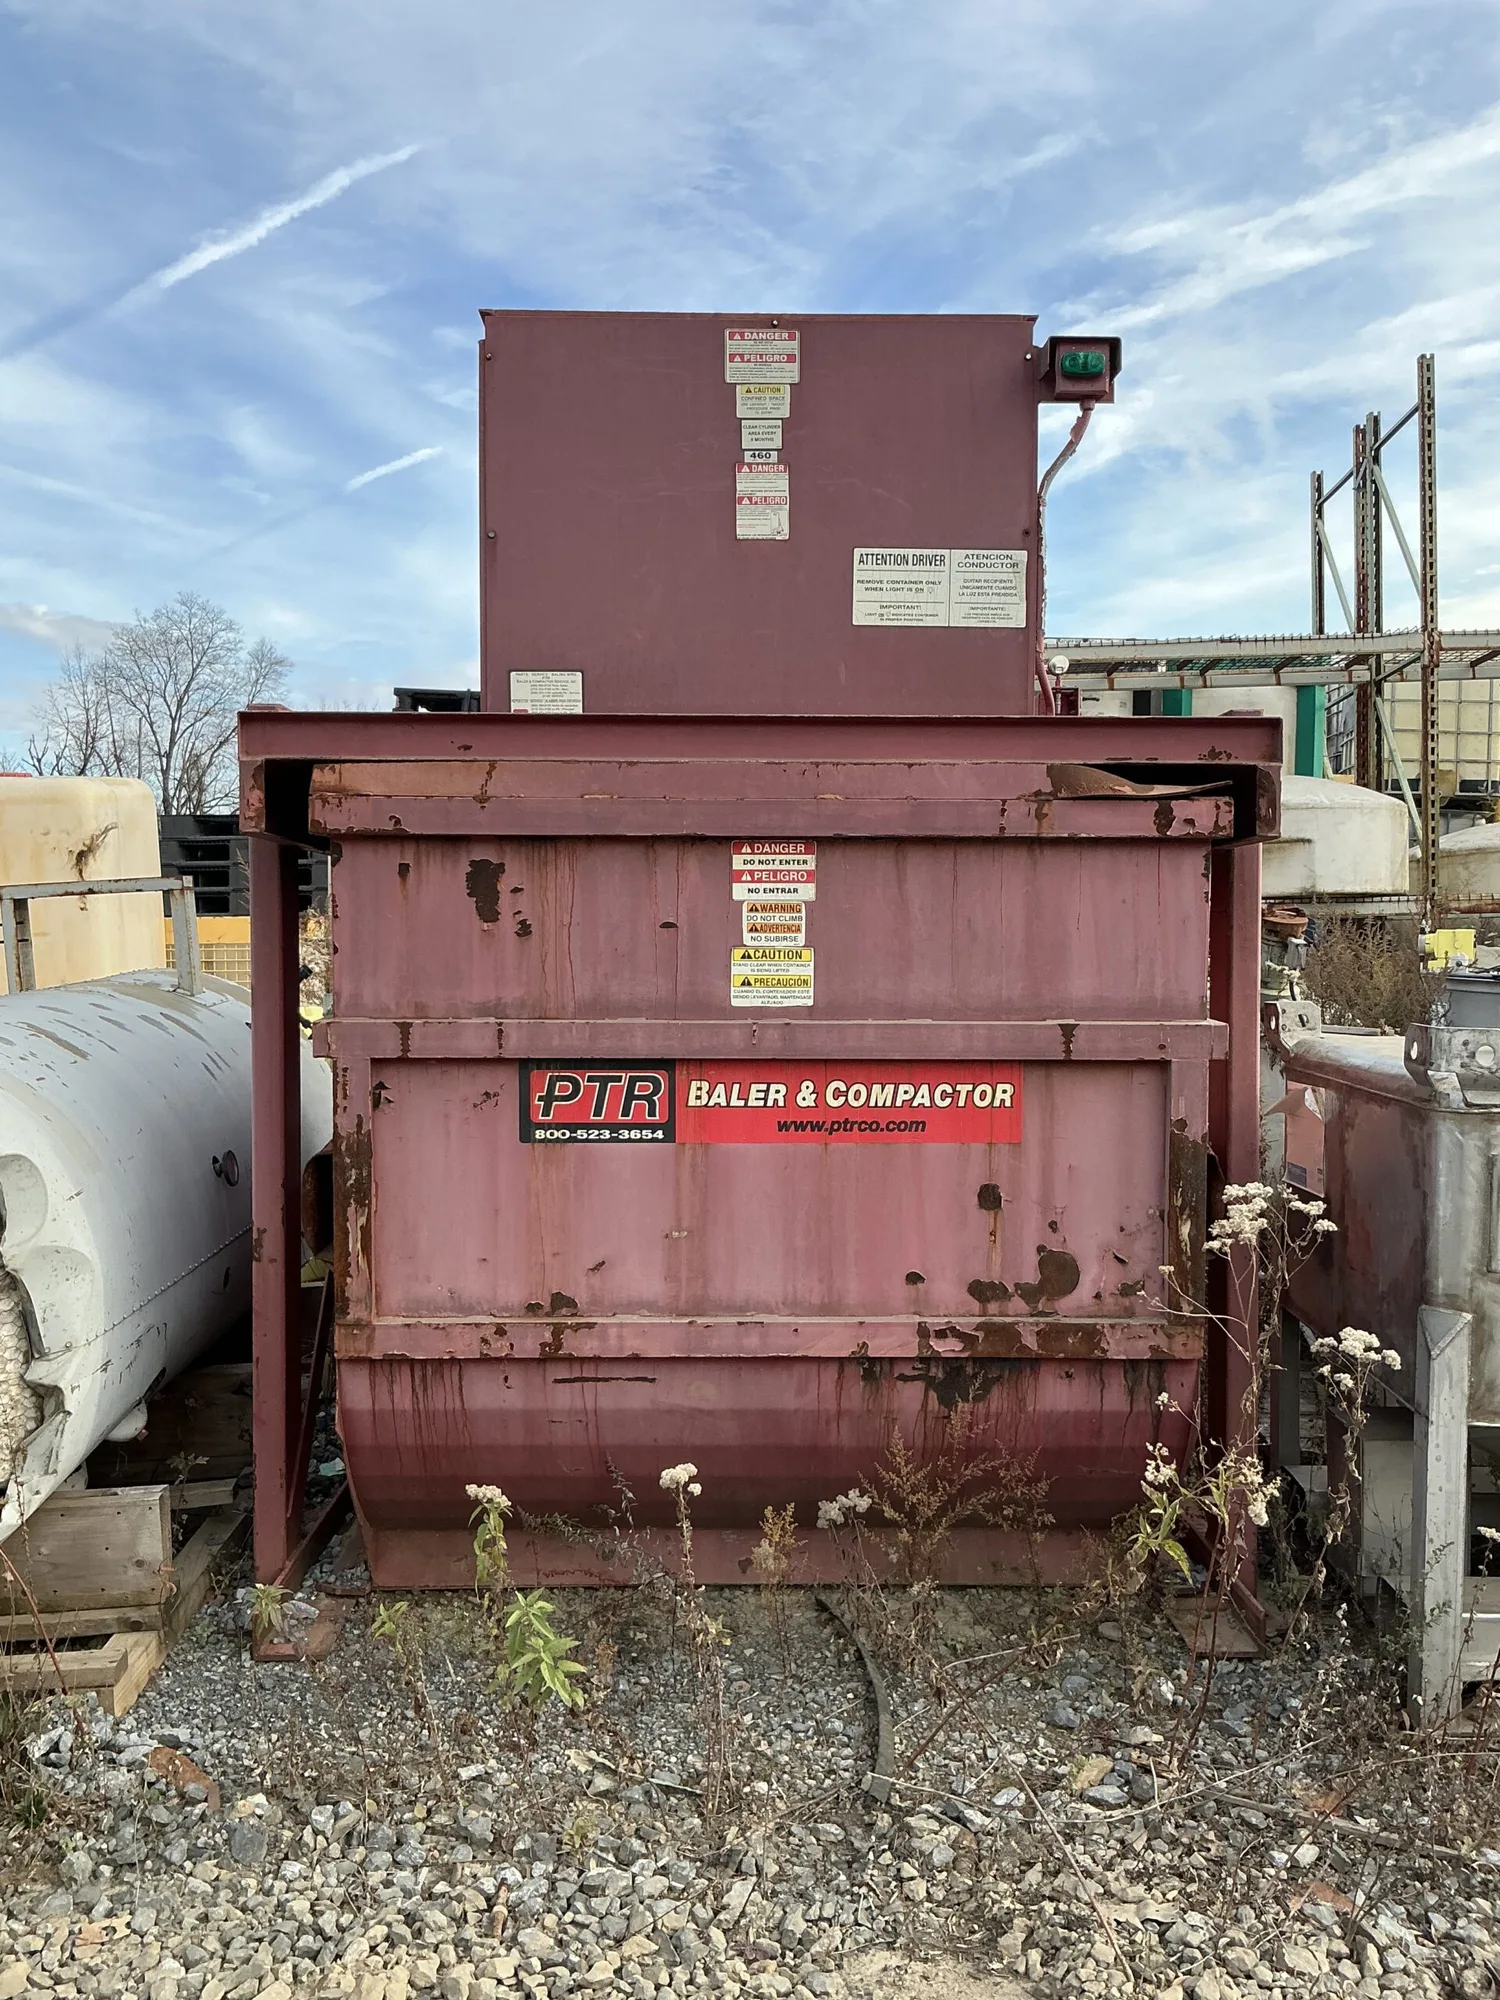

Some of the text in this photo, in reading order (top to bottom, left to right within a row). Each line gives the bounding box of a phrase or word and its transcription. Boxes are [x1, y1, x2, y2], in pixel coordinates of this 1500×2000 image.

[744, 332, 789, 340] DANGER
[858, 553, 945, 567] ATTENTION DRIVER
[754, 844, 805, 853] DANGER
[754, 872, 807, 881] PELIGRO
[760, 904, 802, 913] WARNING
[760, 924, 801, 933] ADVERTENCIA
[753, 950, 802, 959] CAUTION
[754, 976, 809, 986] PRECAUCIÓN
[535, 1072, 664, 1120] PTR
[686, 1079, 1015, 1108] BALER & COMPACTOR
[777, 1118, 927, 1135] www.ptrco.com
[535, 1130, 664, 1139] 800-523-3654
